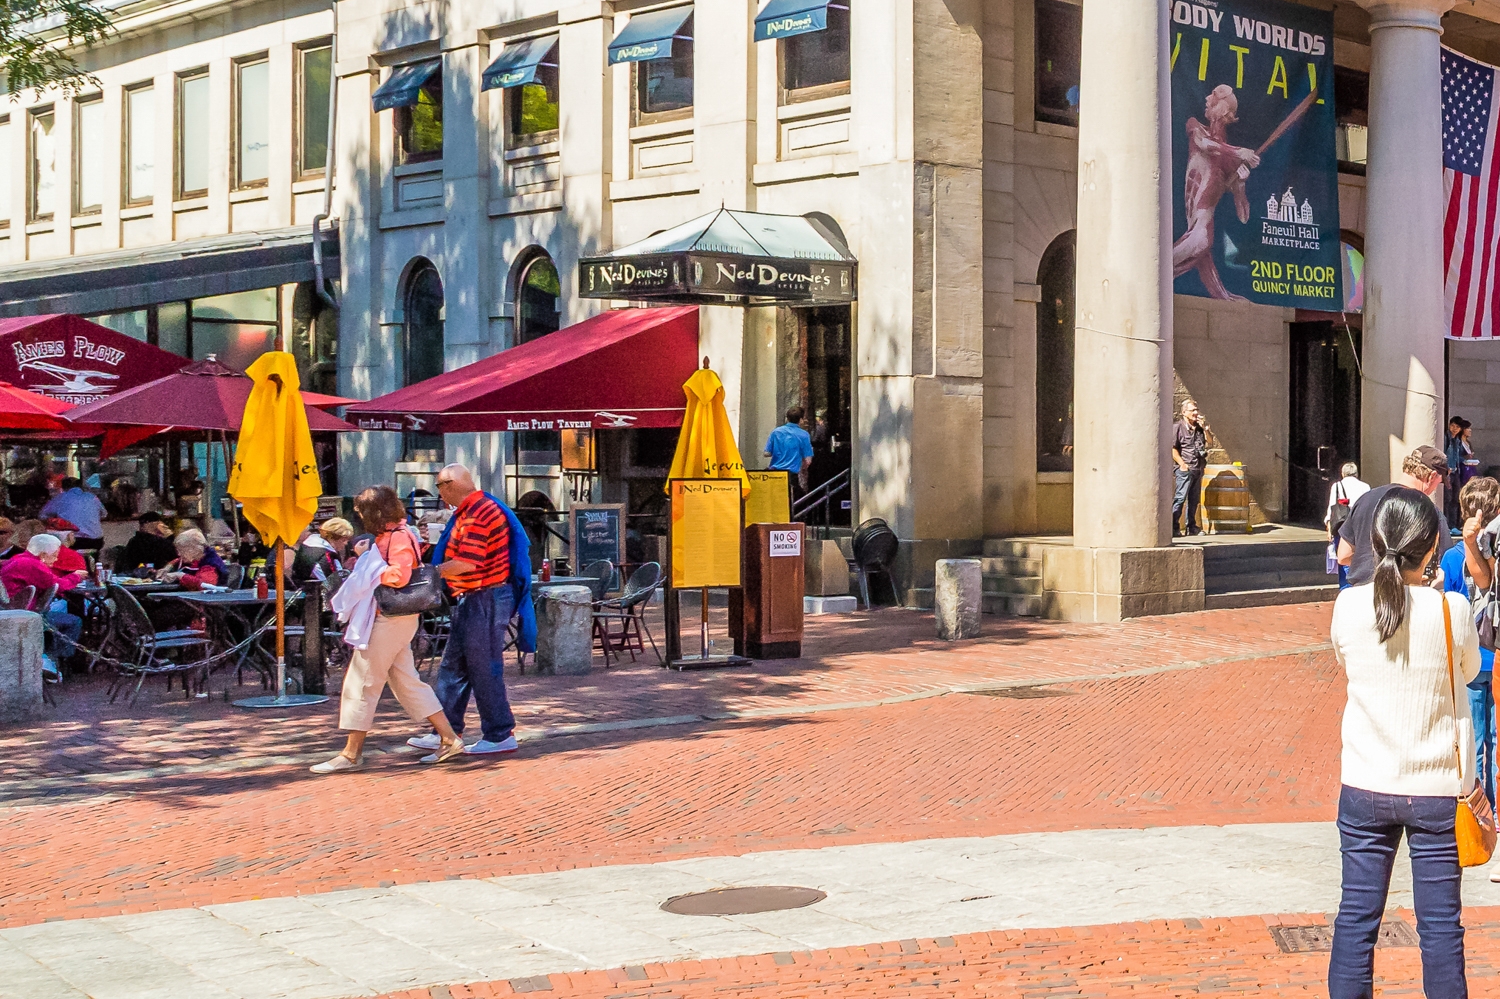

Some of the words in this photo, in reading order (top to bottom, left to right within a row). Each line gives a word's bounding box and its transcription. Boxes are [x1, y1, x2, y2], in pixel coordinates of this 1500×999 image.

[1169, 0, 1224, 32] ODY
[1233, 15, 1325, 56] WORLDS
[1262, 221, 1296, 238] Faneuil
[1298, 226, 1319, 240] Hall
[1261, 236, 1320, 250] MARKETPLACE
[600, 264, 623, 285] Ned
[716, 262, 756, 285] Ned
[1250, 260, 1282, 279] 2ND
[1286, 263, 1335, 284] FLOOR
[1252, 280, 1290, 295] QUINCY
[1293, 284, 1335, 298] MARKET
[685, 485, 702, 494] Ned
[773, 533, 785, 541] NO
